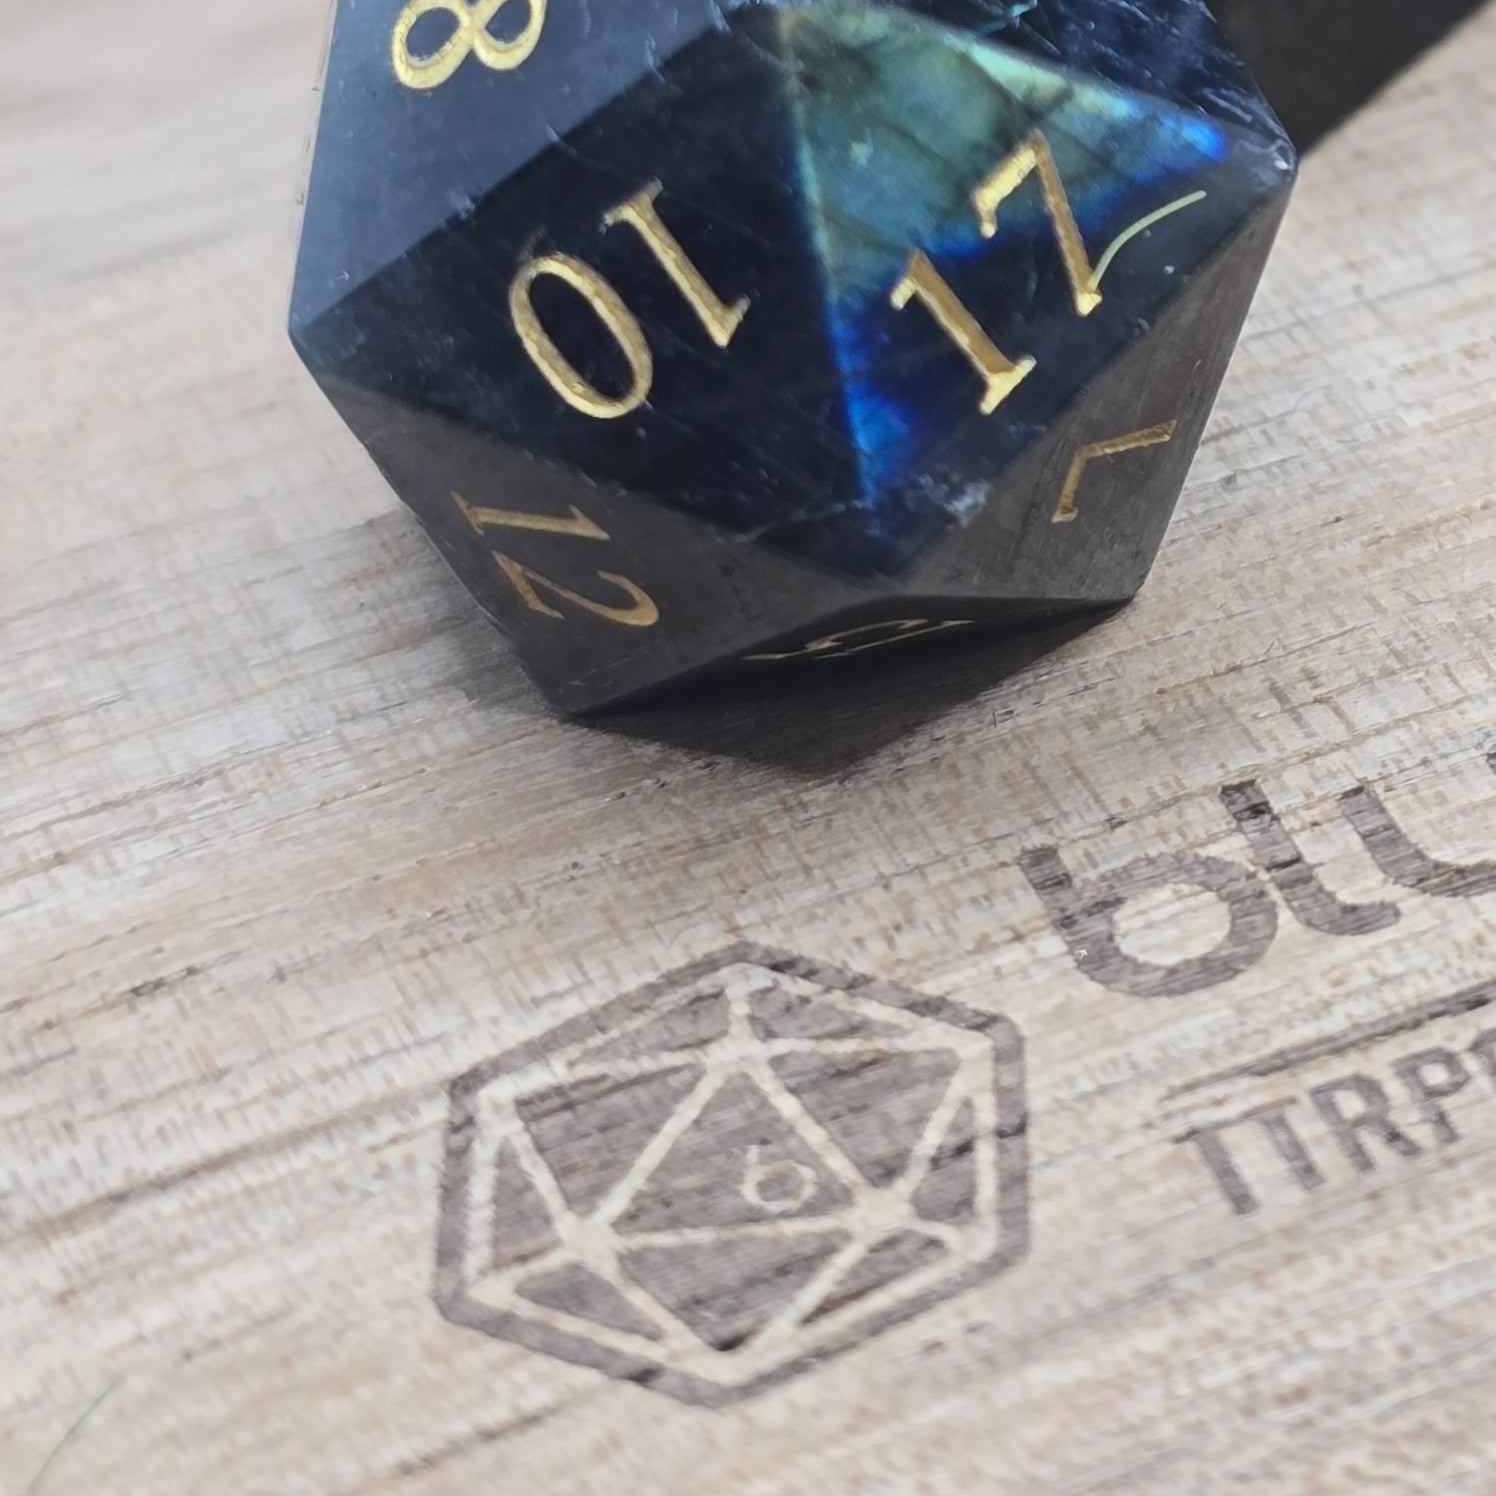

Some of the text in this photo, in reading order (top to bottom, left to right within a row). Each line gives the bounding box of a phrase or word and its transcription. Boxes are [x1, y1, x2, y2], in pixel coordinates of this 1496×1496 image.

[508, 177, 750, 419] 10
[889, 128, 1103, 414] 17
[450, 490, 660, 627] 12
